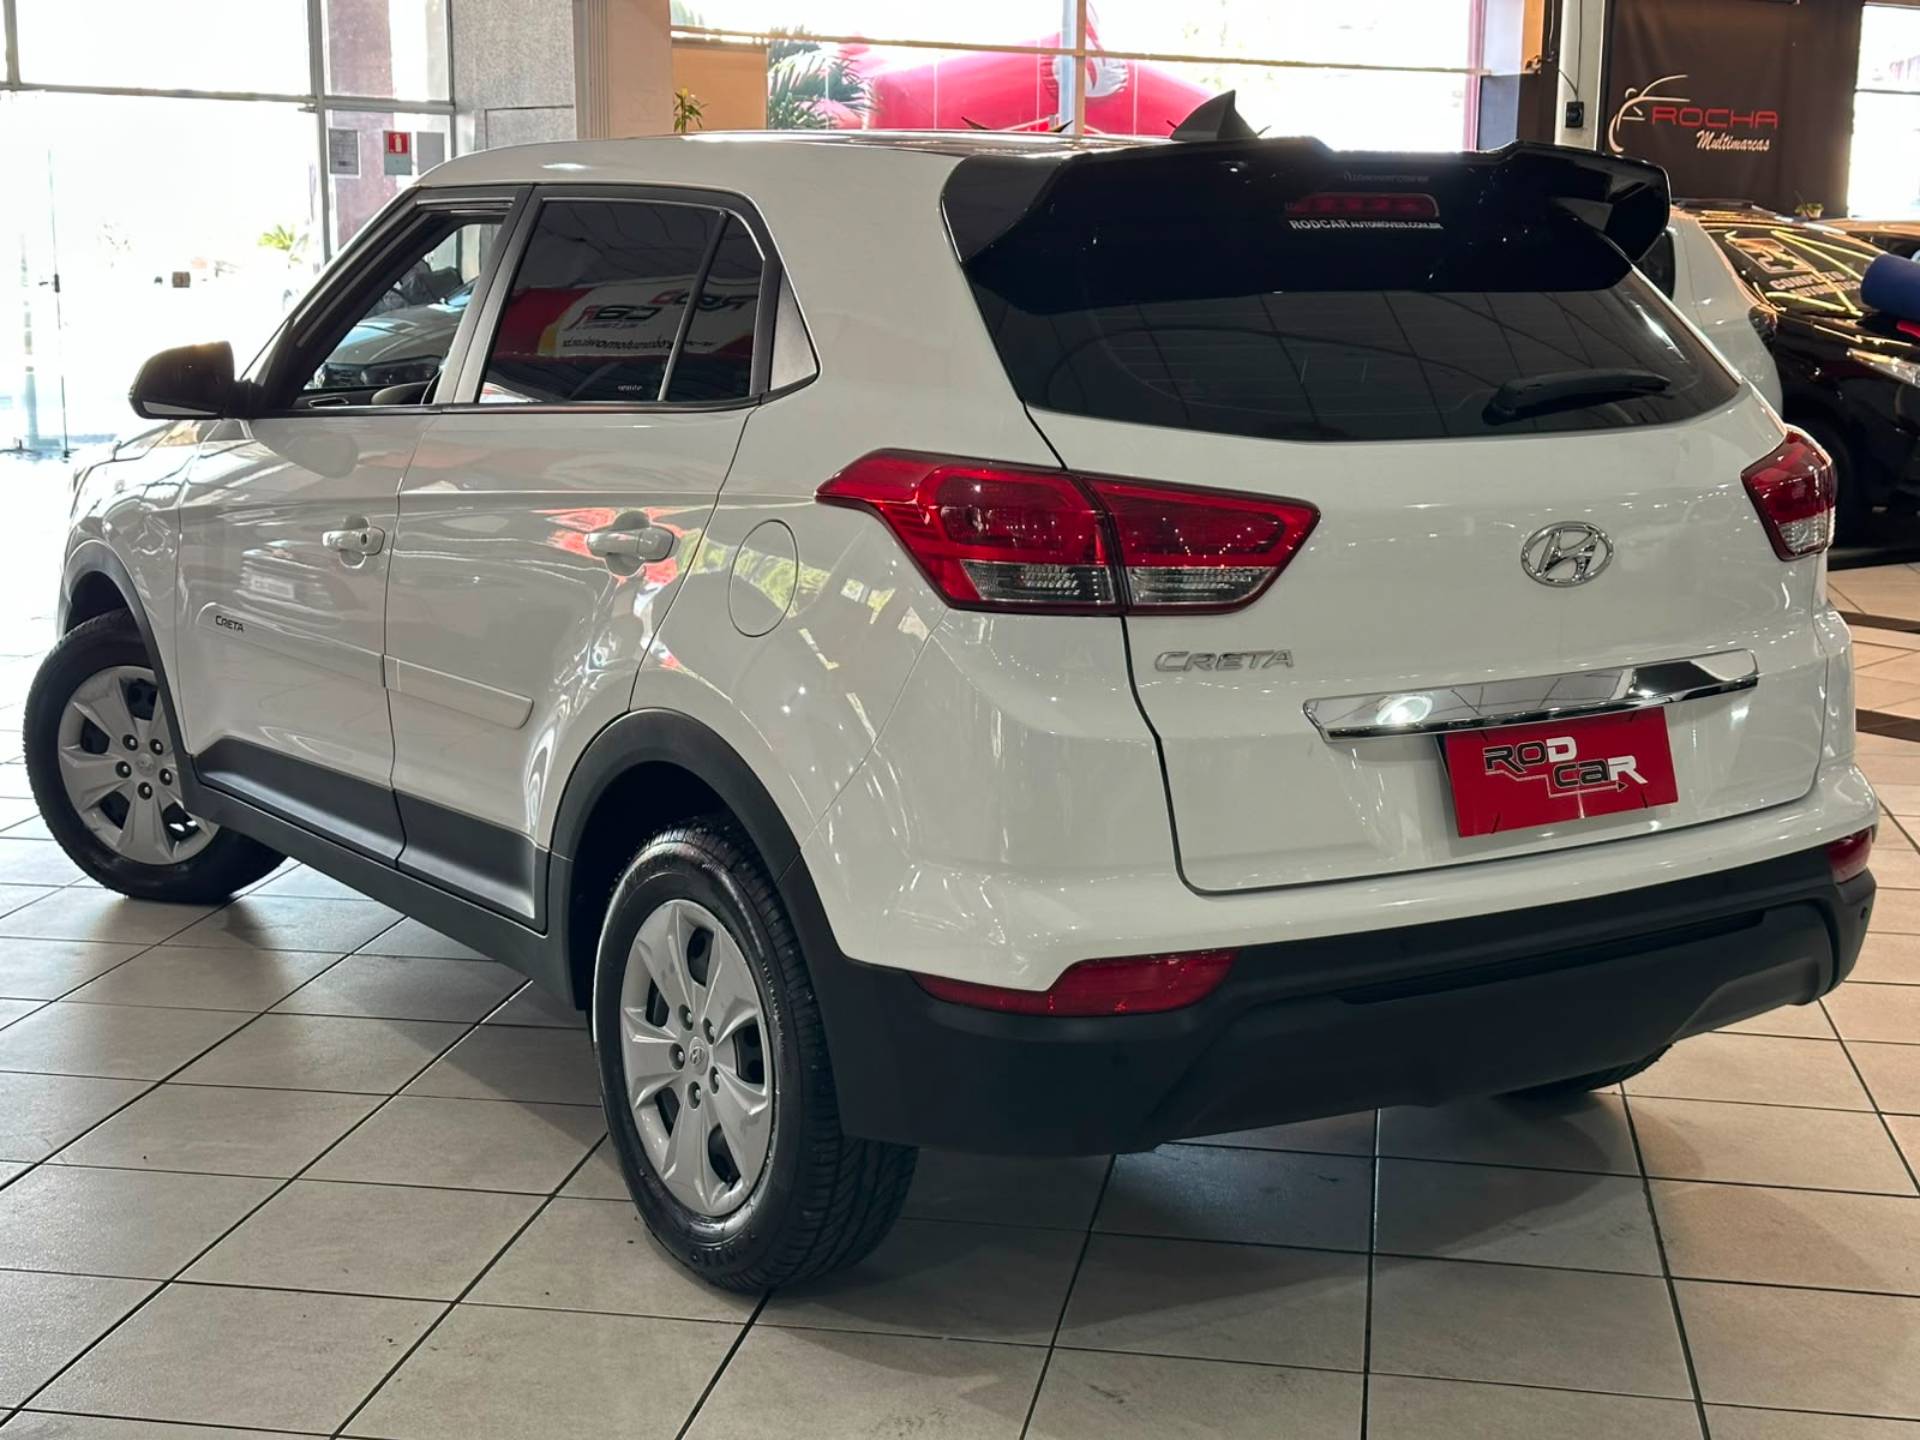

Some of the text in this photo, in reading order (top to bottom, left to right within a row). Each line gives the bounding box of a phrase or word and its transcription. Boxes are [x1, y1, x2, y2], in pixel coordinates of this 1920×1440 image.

[1651, 105, 1779, 129] ROCHA
[1696, 129, 1771, 151] Multimarcas
[215, 615, 244, 632] CRETA
[1154, 650, 1295, 673] CRETA
[1482, 736, 1578, 774] ROD
